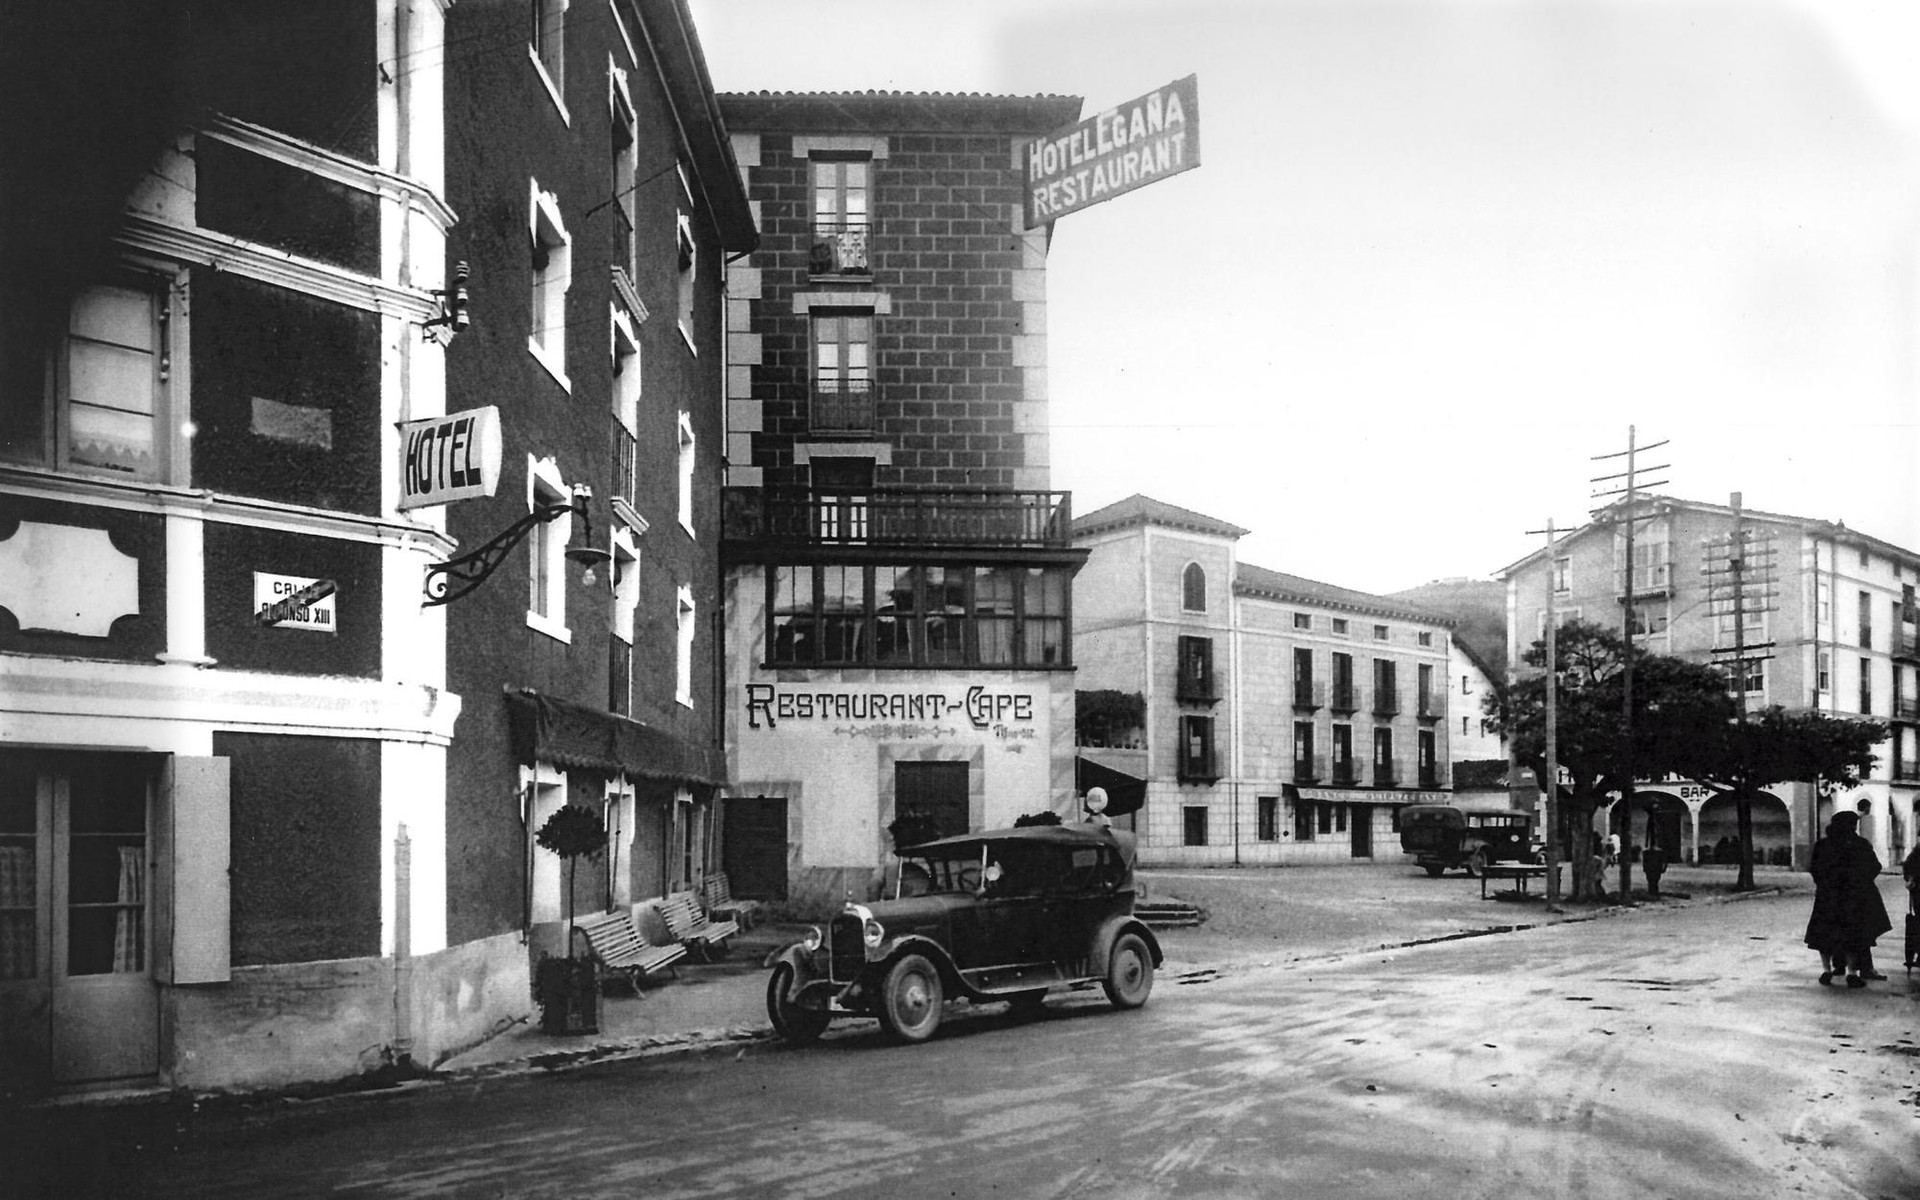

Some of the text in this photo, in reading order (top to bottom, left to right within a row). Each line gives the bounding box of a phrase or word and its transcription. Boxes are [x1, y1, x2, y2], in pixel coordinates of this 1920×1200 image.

[1029, 91, 1186, 183] HOTEL EGAÑA
[1033, 131, 1187, 219] RESTAURANT
[405, 416, 482, 496] HOTEL
[314, 607, 330, 624] XIII
[1680, 786, 1710, 798] BAR
